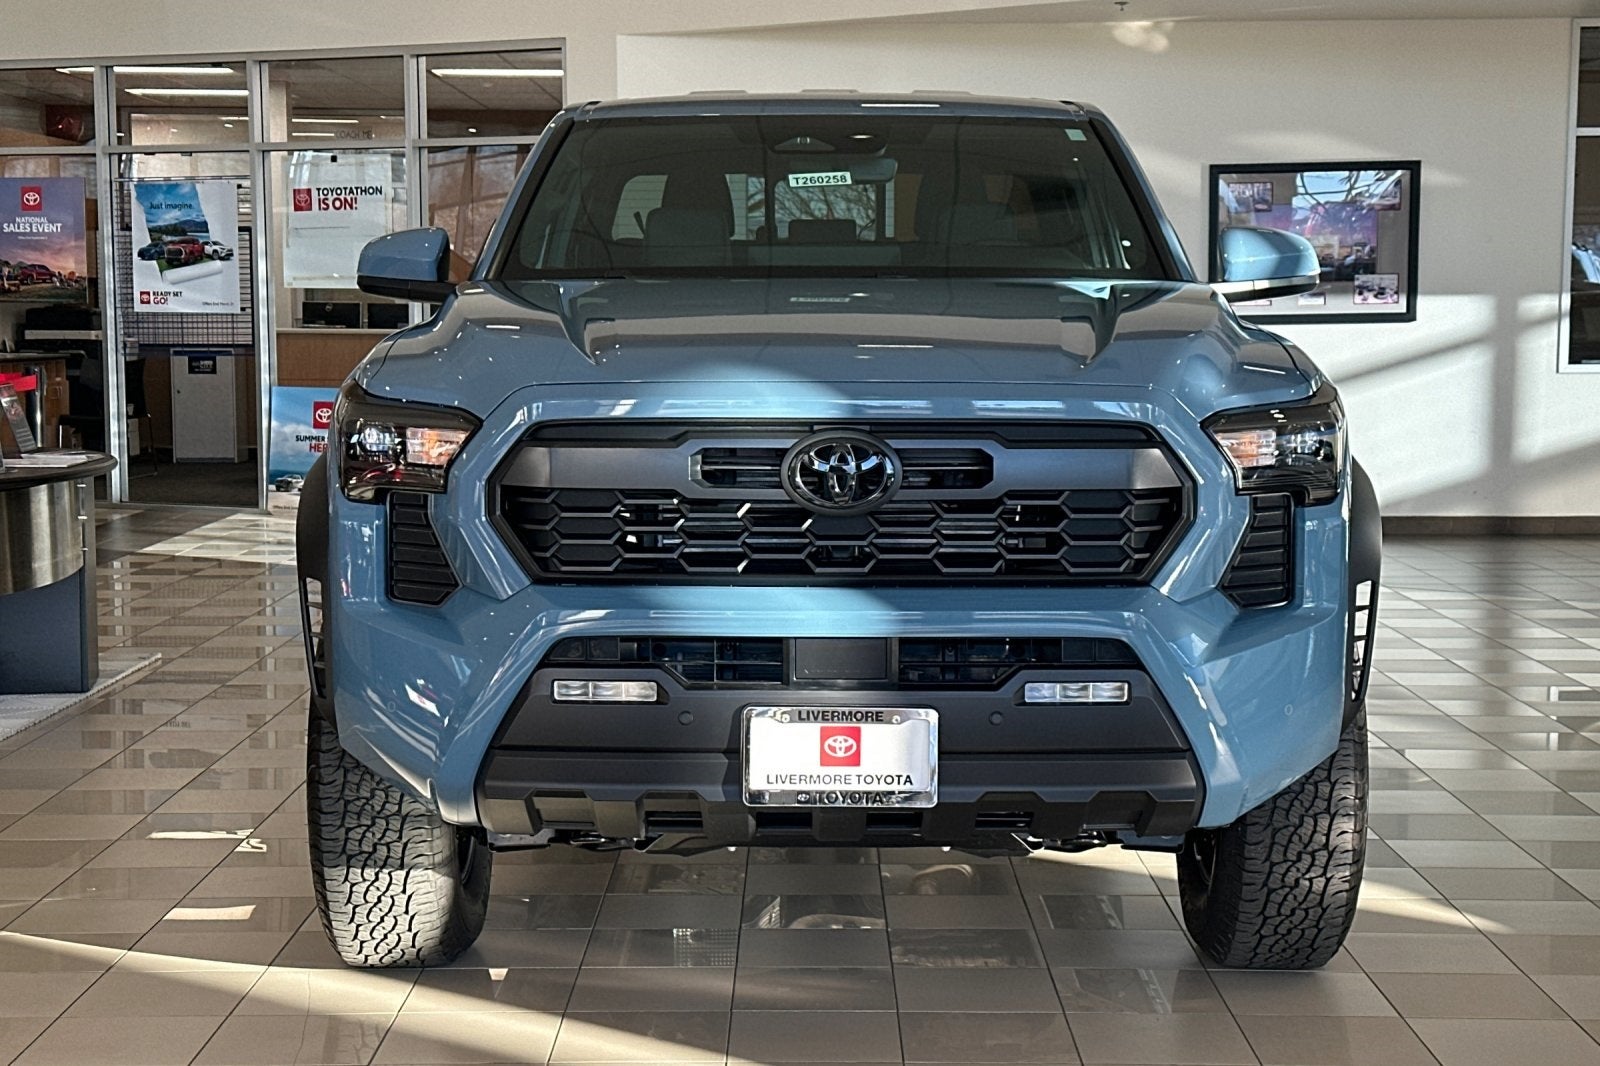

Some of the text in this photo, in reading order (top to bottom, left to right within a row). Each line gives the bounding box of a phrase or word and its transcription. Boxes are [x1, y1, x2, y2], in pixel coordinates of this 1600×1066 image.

[793, 175, 848, 185] T260258
[316, 186, 383, 197] TOYOTATHON
[318, 197, 358, 211] IS ON!
[3, 223, 62, 233] SALES EVENT
[153, 297, 169, 305] GO!
[309, 443, 329, 452] HER
[798, 710, 884, 722] LIVERMORE
[767, 774, 914, 785] LIVERMORE TOYOTA
[815, 791, 885, 805] TOYOTA
